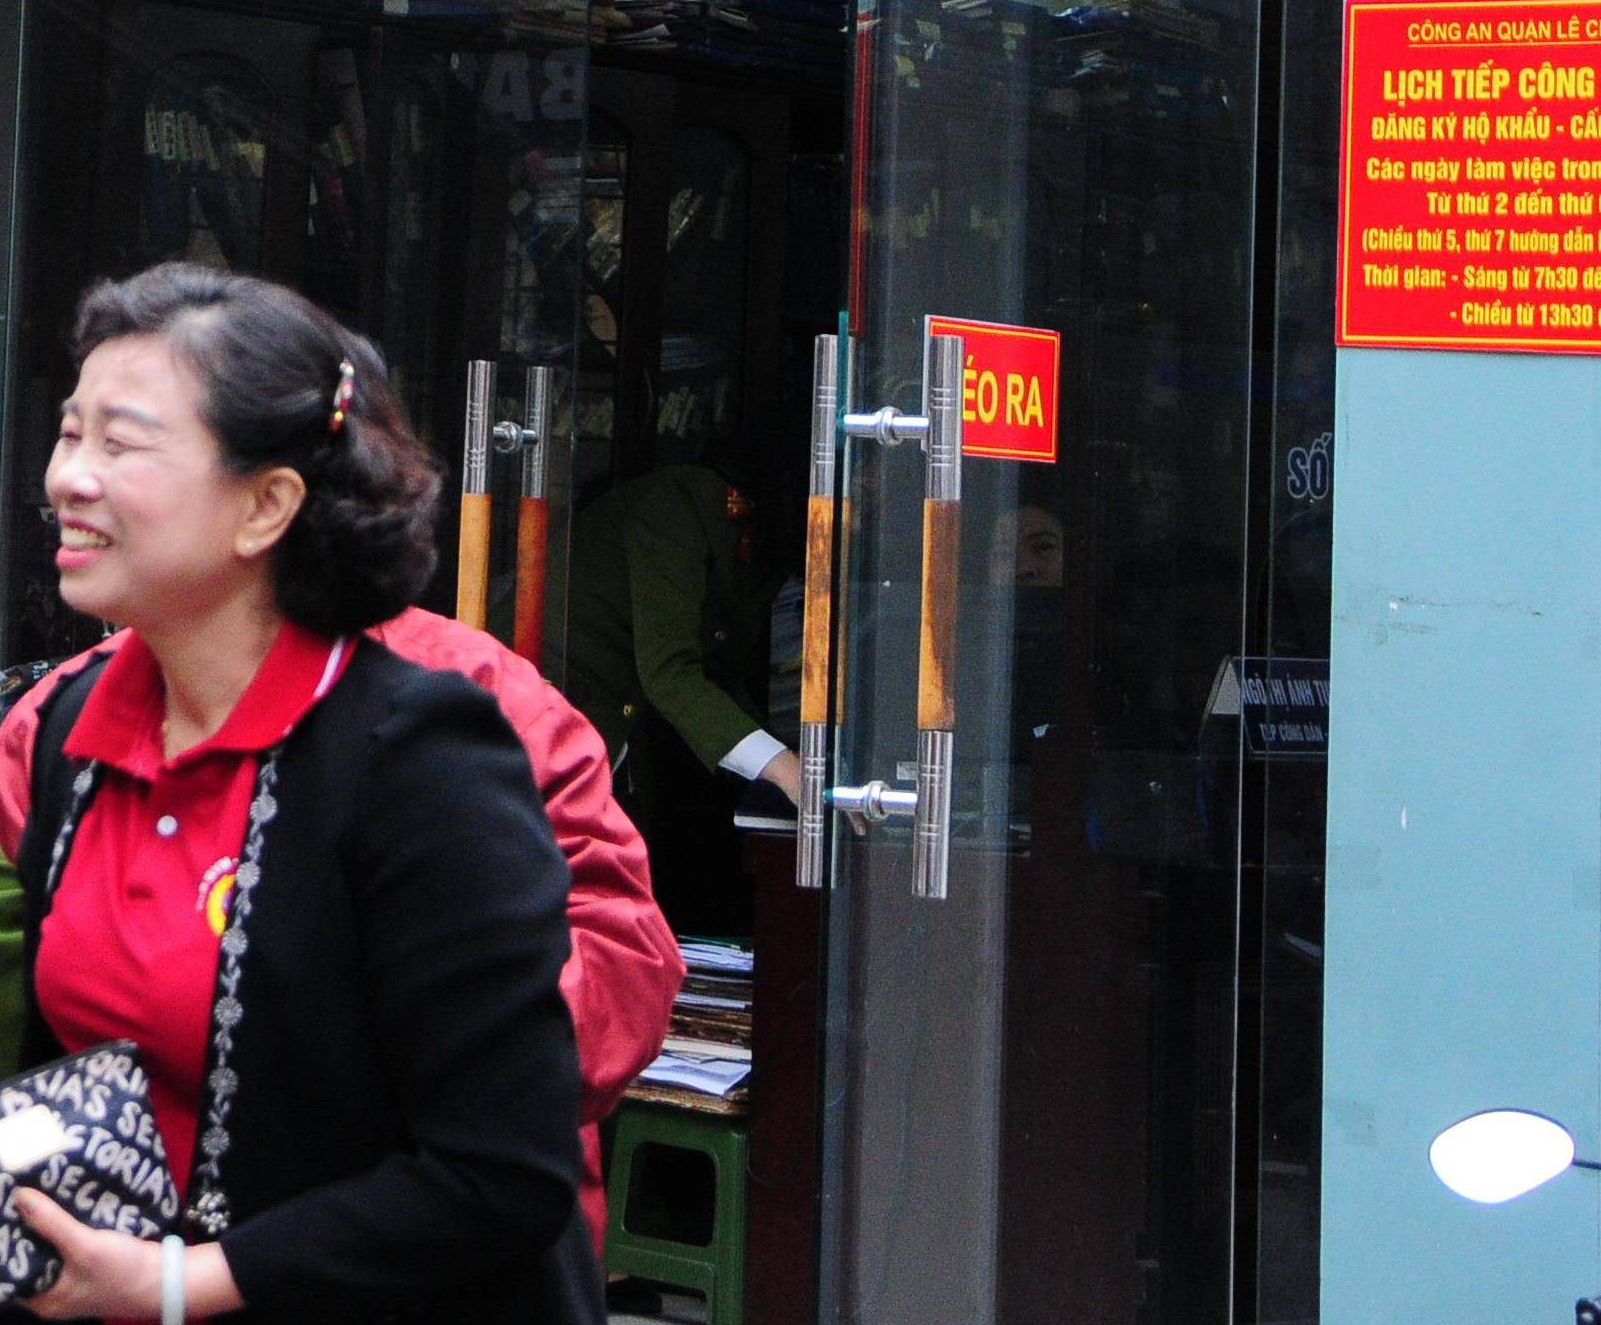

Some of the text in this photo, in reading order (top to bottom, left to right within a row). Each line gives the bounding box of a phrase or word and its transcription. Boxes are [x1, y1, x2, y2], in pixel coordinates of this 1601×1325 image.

[1407, 19, 1461, 42] CÔNG
[1466, 22, 1493, 41] AN
[1557, 15, 1580, 39] LÊ
[1585, 19, 1601, 39] C
[1383, 58, 1596, 107] LỊCH TIẾP CÔNG
[1371, 112, 1426, 141] ĐĂNG
[1432, 111, 1457, 141] KÝ
[1463, 111, 1490, 145] HỘ
[1496, 106, 1551, 140] KHẨU
[1570, 107, 1601, 140] CẤ
[1366, 157, 1405, 181] Các
[1411, 157, 1461, 183] ngày
[1466, 156, 1506, 181] làm
[1511, 156, 1556, 184] việc
[1427, 187, 1594, 216] Từ thứ 2 đến thứ
[1362, 224, 1414, 253] (Chiều
[1417, 228, 1443, 252] thứ
[1446, 228, 1461, 253] 5,
[1465, 228, 1491, 252] thứ
[1495, 228, 1506, 252] 7
[1563, 225, 1595, 253] dẫn
[1362, 263, 1399, 288] Thời
[1404, 264, 1447, 290] gian:
[1463, 264, 1508, 292] Sáng
[1512, 265, 1531, 290] từ
[1534, 265, 1579, 291] 7h30
[1461, 298, 1513, 327] Chiều
[1516, 302, 1535, 327] từ
[1539, 303, 1594, 328] 13h30
[963, 354, 1044, 428] ÉO RA
[1287, 431, 1333, 500] SỐ
